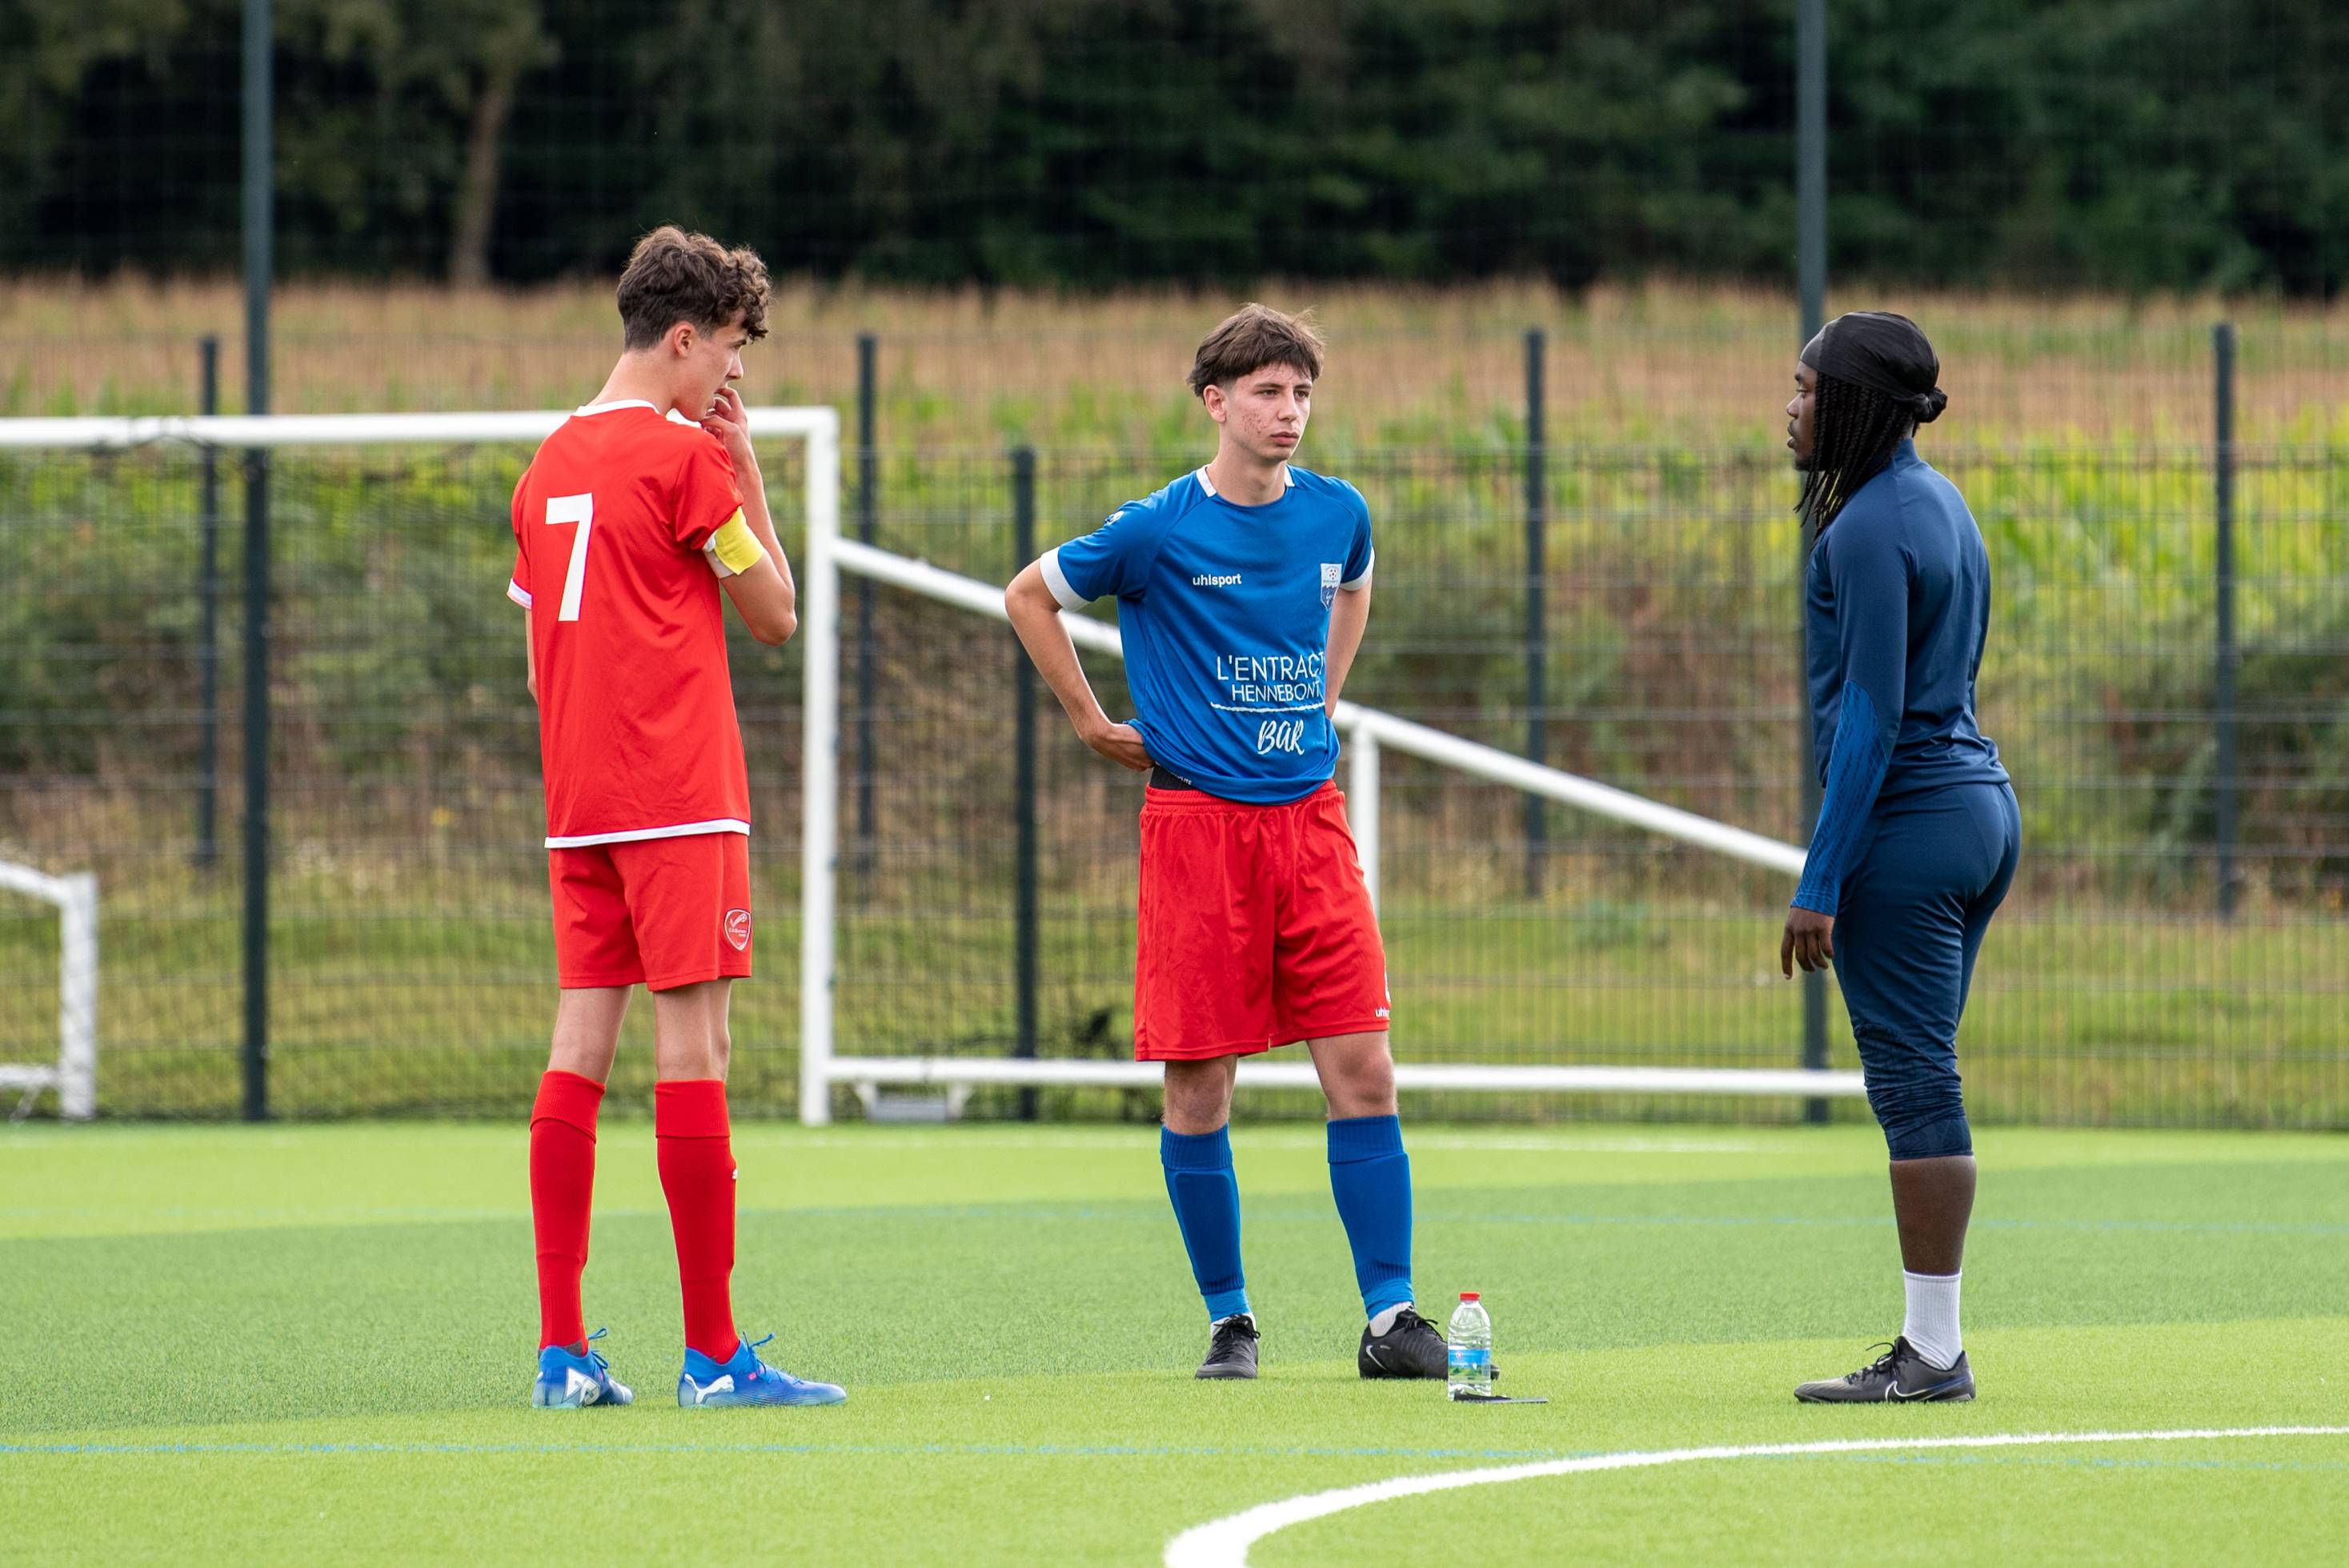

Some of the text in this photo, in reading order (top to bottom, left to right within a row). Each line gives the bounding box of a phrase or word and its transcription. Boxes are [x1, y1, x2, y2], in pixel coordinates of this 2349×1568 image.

[545, 492, 594, 622] 7
[1193, 573, 1242, 588] uhlsport
[1232, 680, 1320, 702] HENNEBONT
